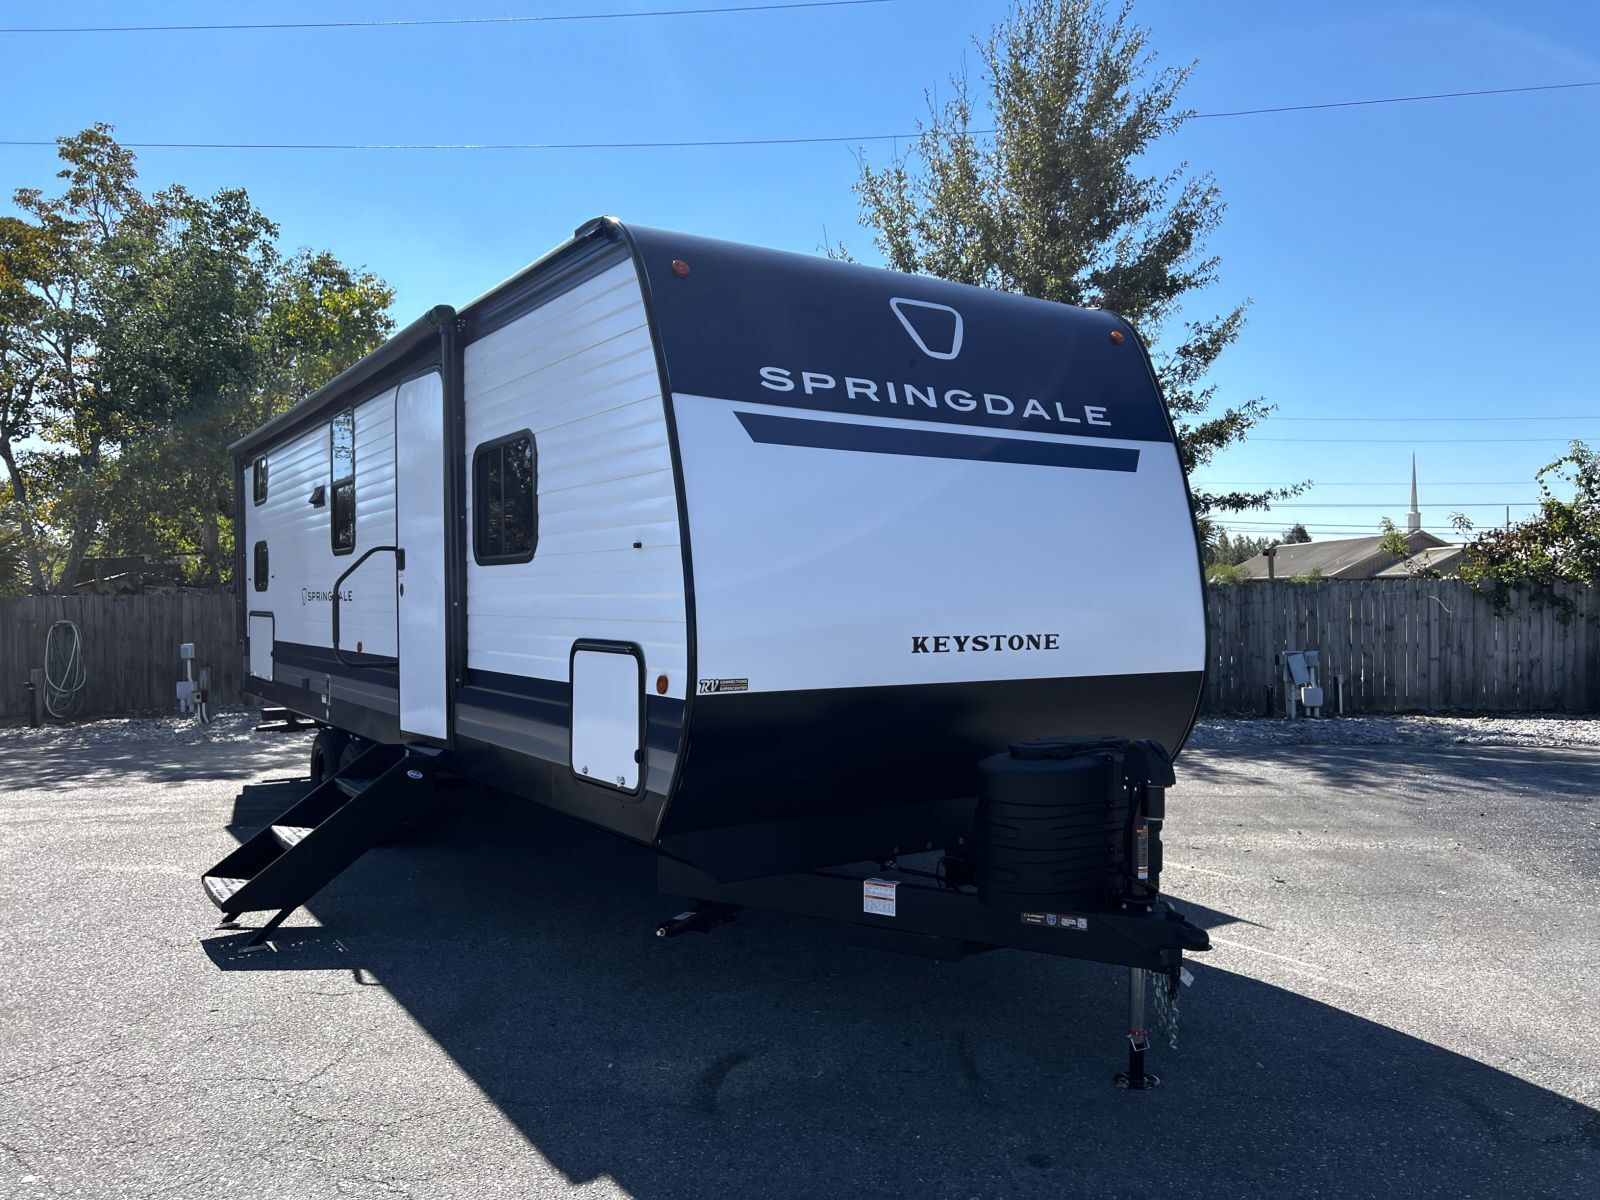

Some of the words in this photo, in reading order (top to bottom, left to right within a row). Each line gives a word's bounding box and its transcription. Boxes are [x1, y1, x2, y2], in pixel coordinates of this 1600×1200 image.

[759, 366, 1112, 427] SPRINGDALE
[307, 591, 353, 602] SPRINGALE
[912, 634, 1060, 654] KEYSTONE
[699, 679, 719, 693] RV
